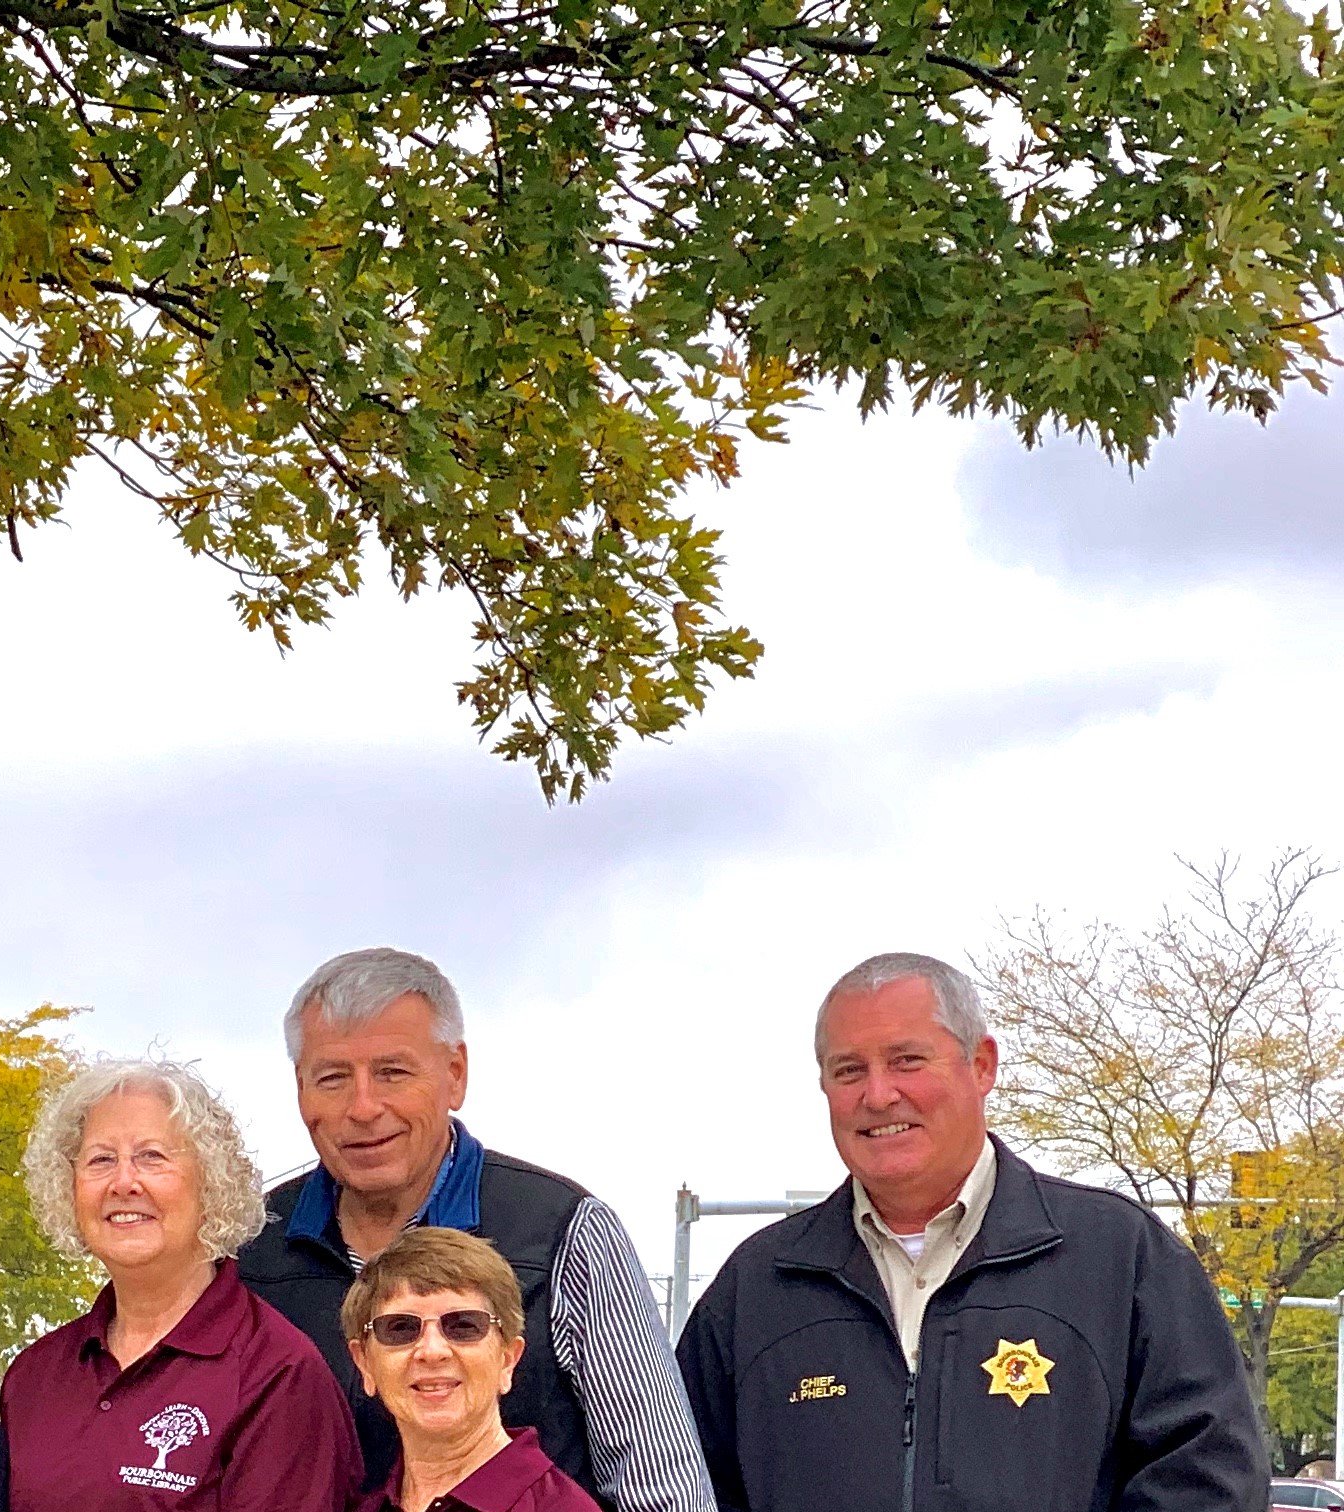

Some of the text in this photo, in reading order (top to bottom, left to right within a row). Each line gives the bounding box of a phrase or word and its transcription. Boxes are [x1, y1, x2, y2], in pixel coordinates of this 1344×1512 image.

[997, 1350, 1040, 1368] BOURBONNAIS
[800, 1375, 836, 1390] CHIEF
[1005, 1382, 1033, 1391] POLICE
[789, 1384, 847, 1403] J. PHELPS
[119, 1466, 198, 1486] BOURBONNAIS
[123, 1475, 187, 1492] PUBLIC LIBRARY
